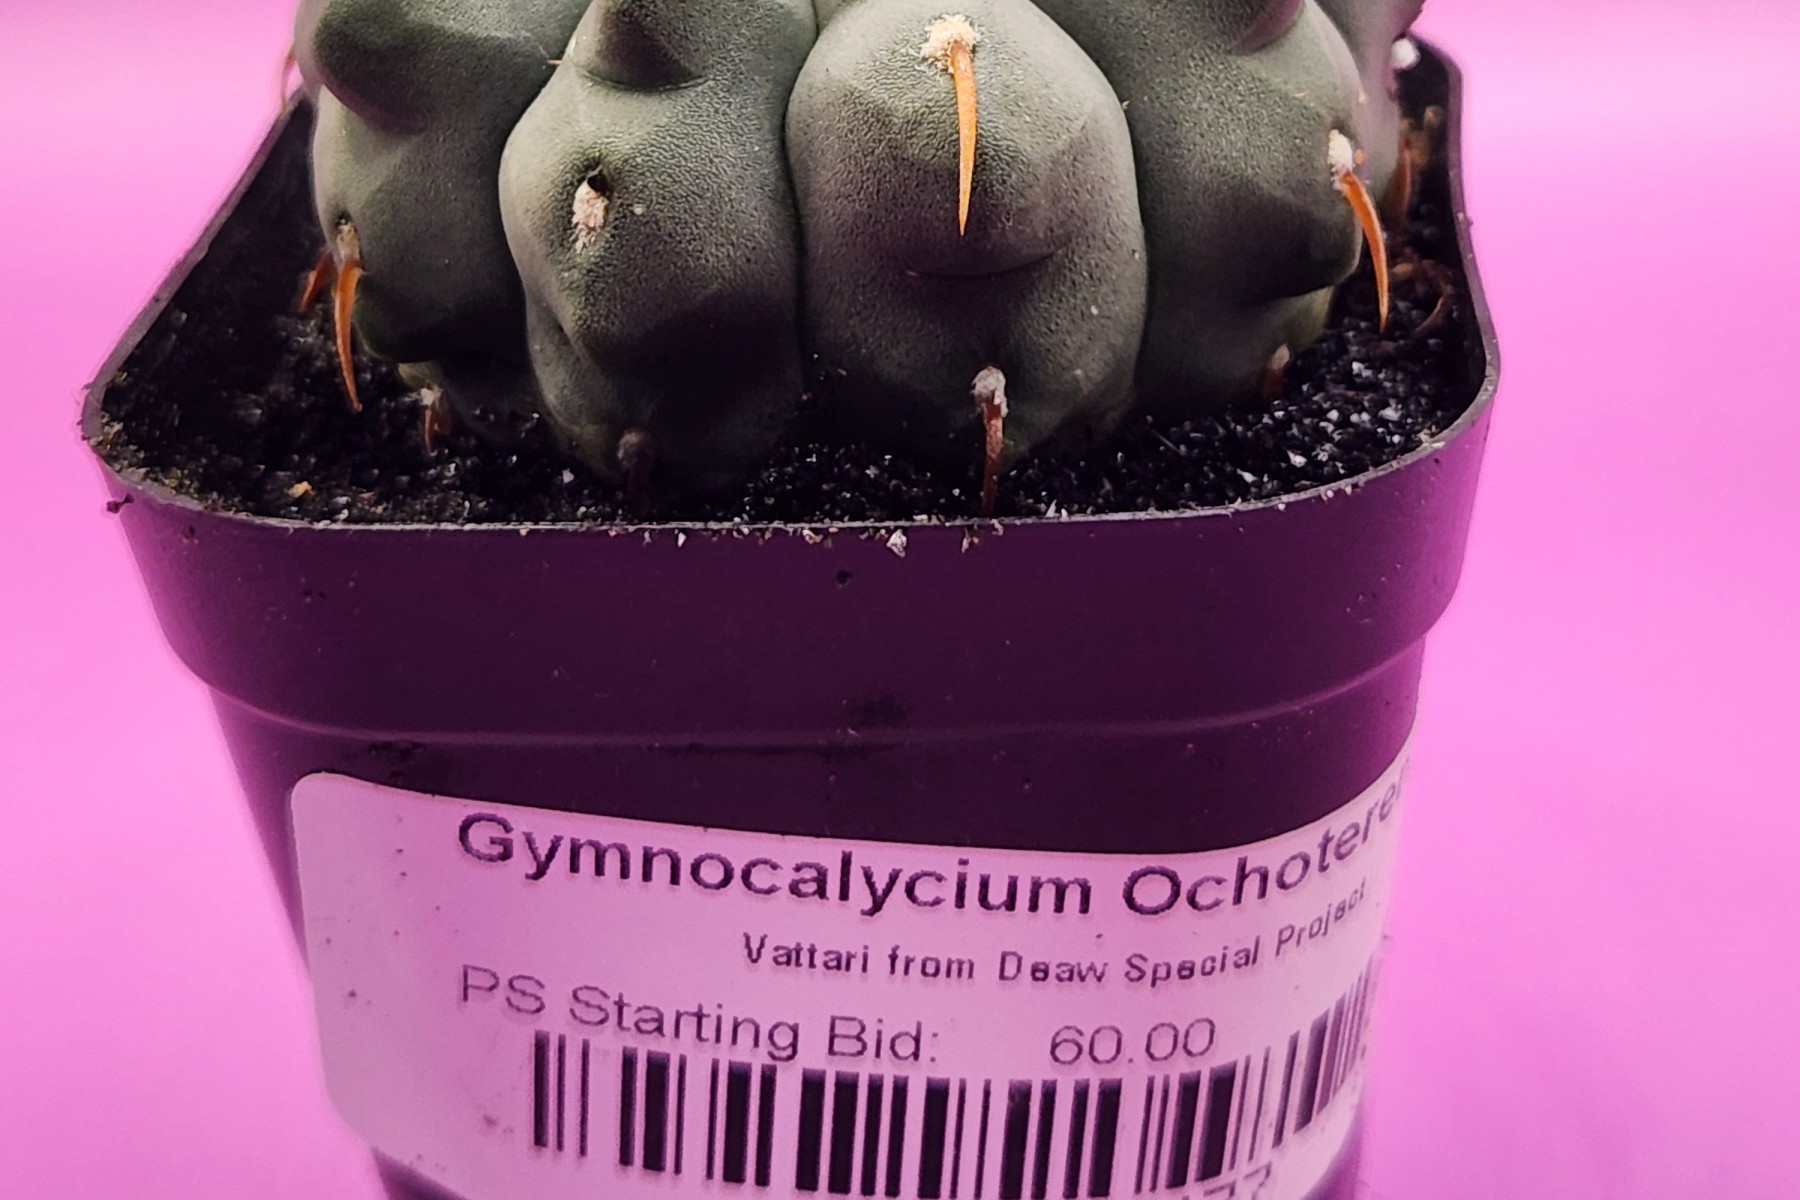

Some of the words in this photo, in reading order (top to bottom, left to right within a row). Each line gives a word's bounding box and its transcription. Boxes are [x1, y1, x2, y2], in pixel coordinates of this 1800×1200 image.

[458, 812, 1092, 918] Gymnocalycium
[1122, 768, 1404, 917] Ochotere
[743, 932, 869, 974] Vattari
[888, 944, 975, 980] from
[998, 950, 1109, 984] Deaw
[1124, 934, 1261, 989] Special
[1275, 876, 1366, 957] Project
[460, 964, 546, 1016] PS
[568, 984, 800, 1063] Starting
[827, 1015, 940, 1065] Bid:
[1050, 1017, 1216, 1065] 60.00
